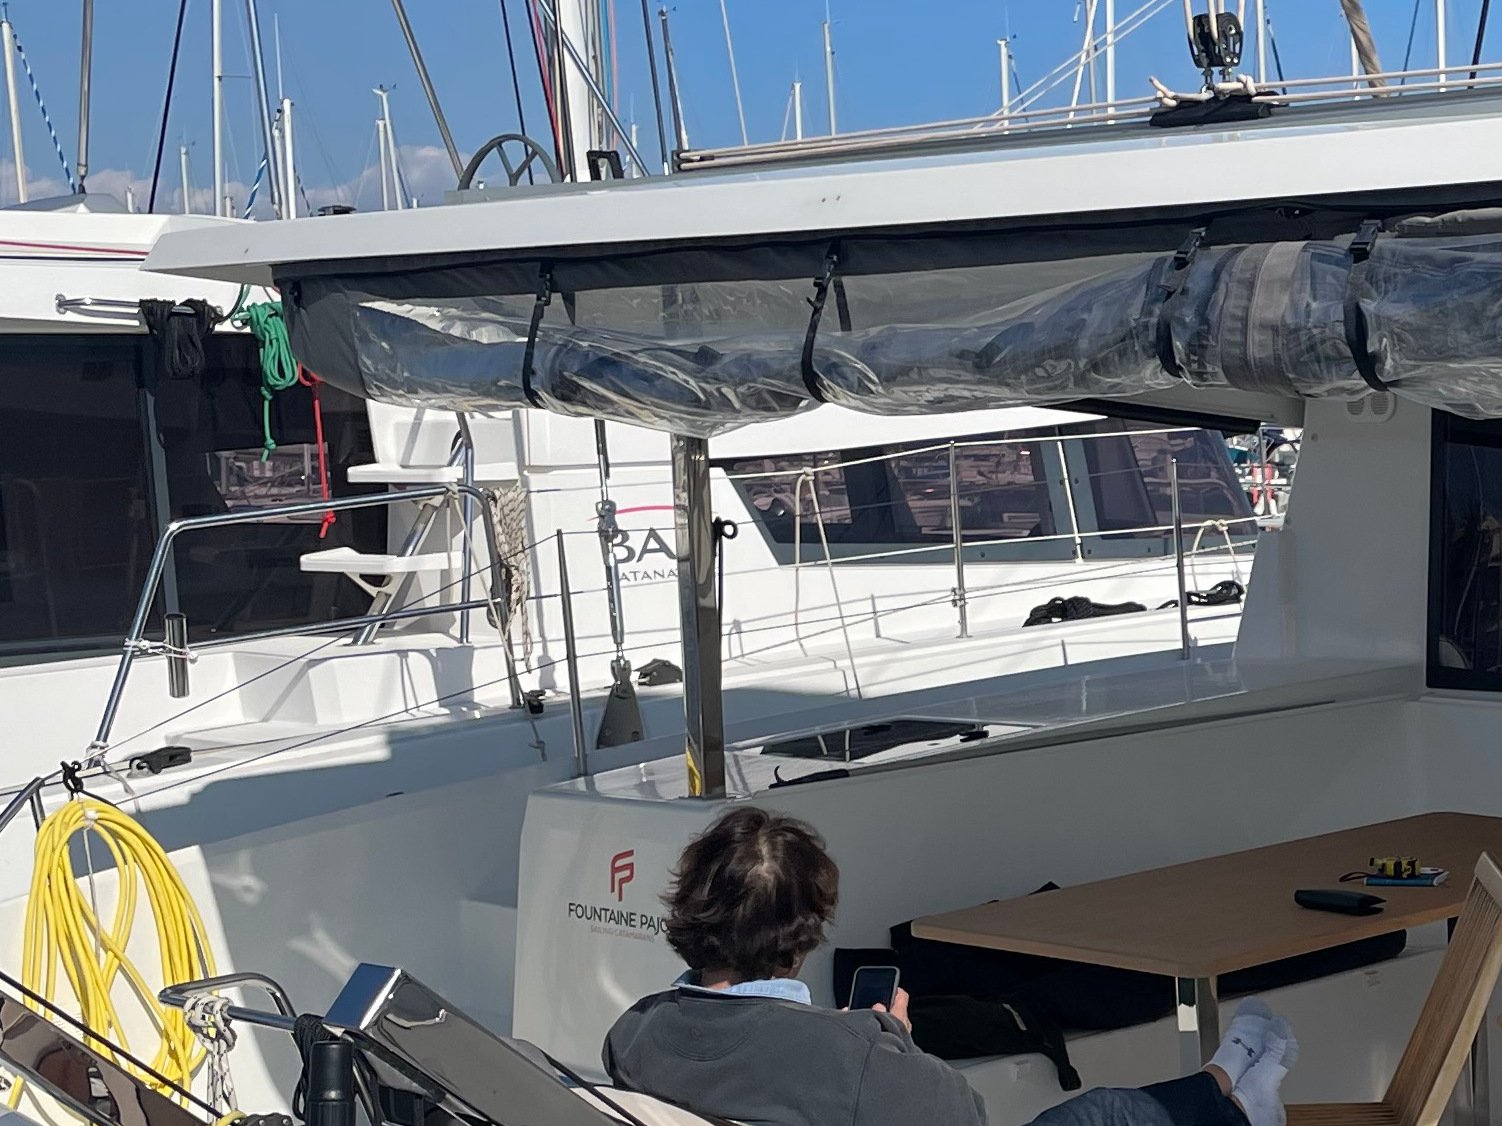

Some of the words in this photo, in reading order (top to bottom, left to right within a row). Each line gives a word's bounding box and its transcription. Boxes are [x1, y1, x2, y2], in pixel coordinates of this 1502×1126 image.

[620, 568, 679, 582] ATANA
[568, 902, 637, 928] FOUNTAINE
[640, 914, 669, 936] PAJO
